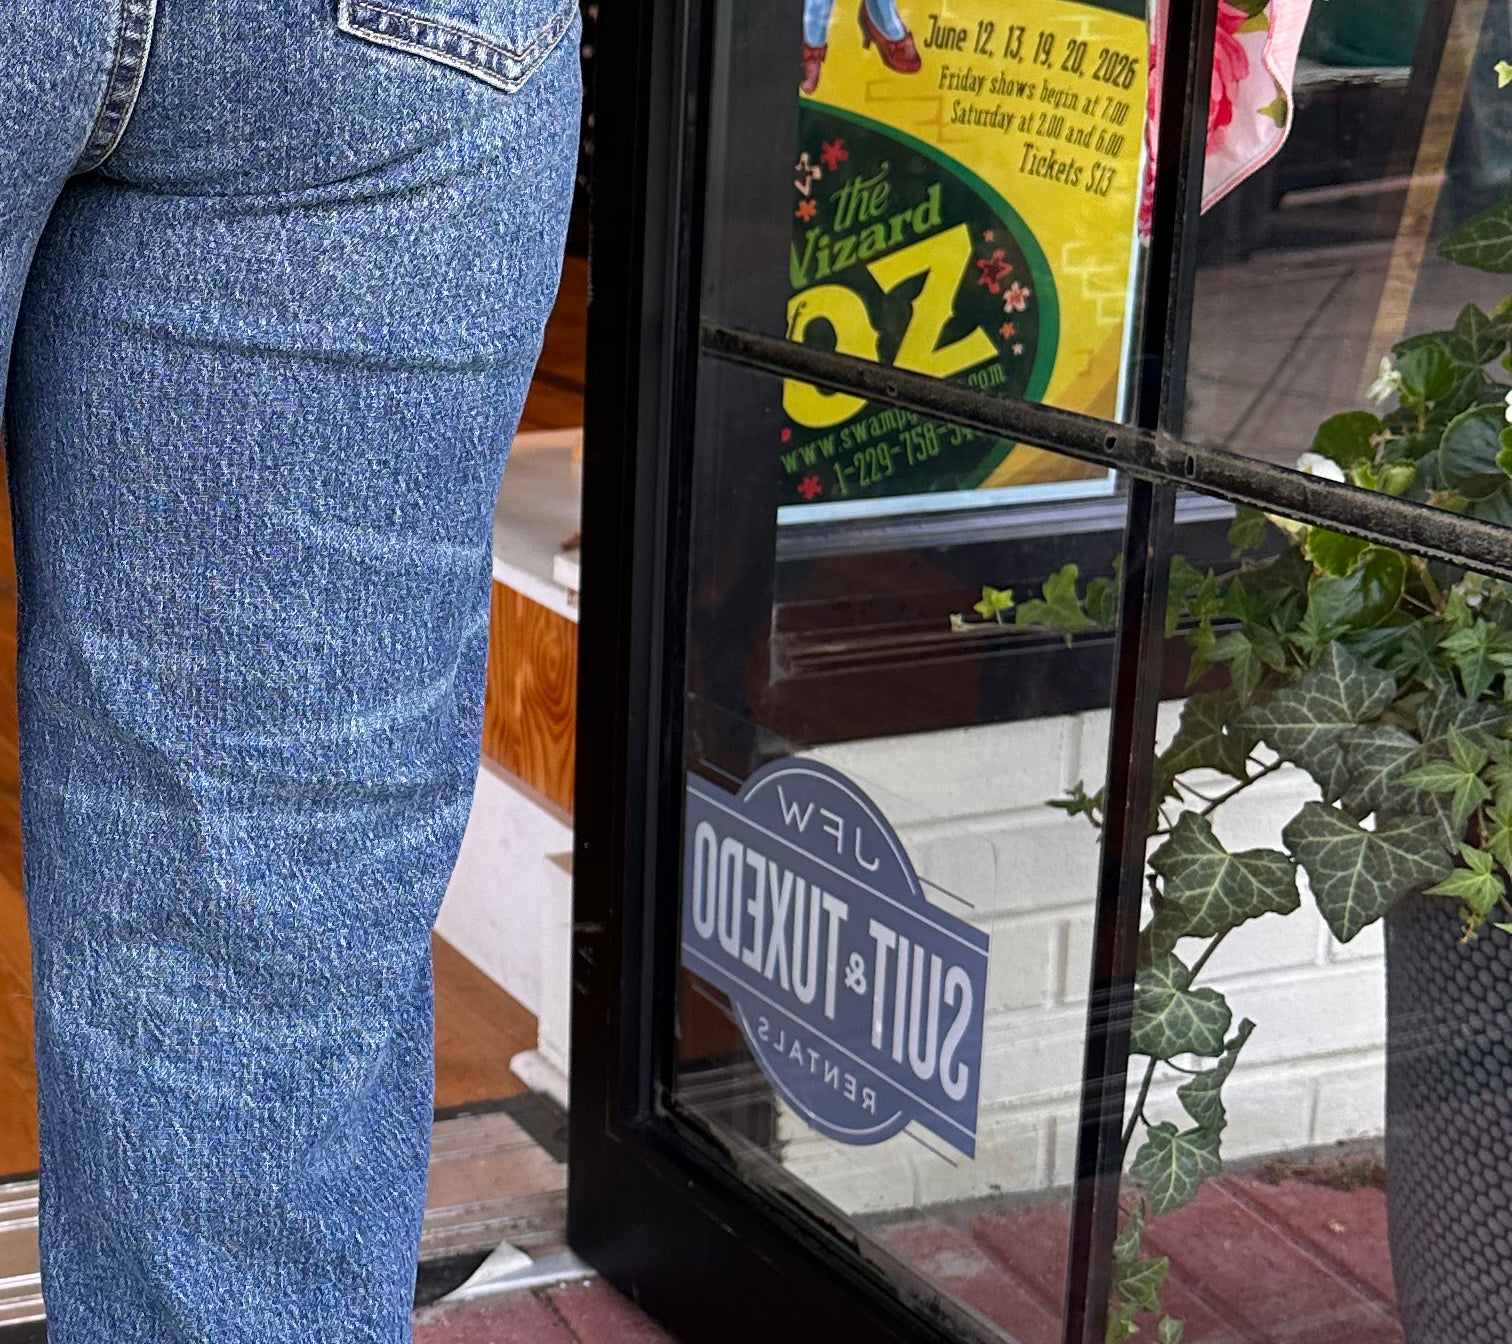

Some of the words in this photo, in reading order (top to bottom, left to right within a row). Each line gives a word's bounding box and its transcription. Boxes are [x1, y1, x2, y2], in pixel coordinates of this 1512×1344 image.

[923, 13, 968, 53] June
[973, 19, 995, 57] 12,
[1003, 24, 1026, 64] 13,
[1032, 30, 1055, 70] 19,
[1060, 37, 1088, 79] 20,
[1091, 47, 1140, 91] 2026
[938, 64, 986, 97] Friday
[989, 71, 1036, 101] shows
[1039, 78, 1080, 112] begin
[1081, 93, 1101, 117] at
[950, 98, 1015, 135] Saturday
[1017, 112, 1034, 135] at
[1064, 124, 1098, 150] and
[828, 160, 890, 233] the
[1018, 140, 1085, 188] Tickets
[1084, 159, 1118, 198] $13
[782, 222, 1000, 430] OZ
